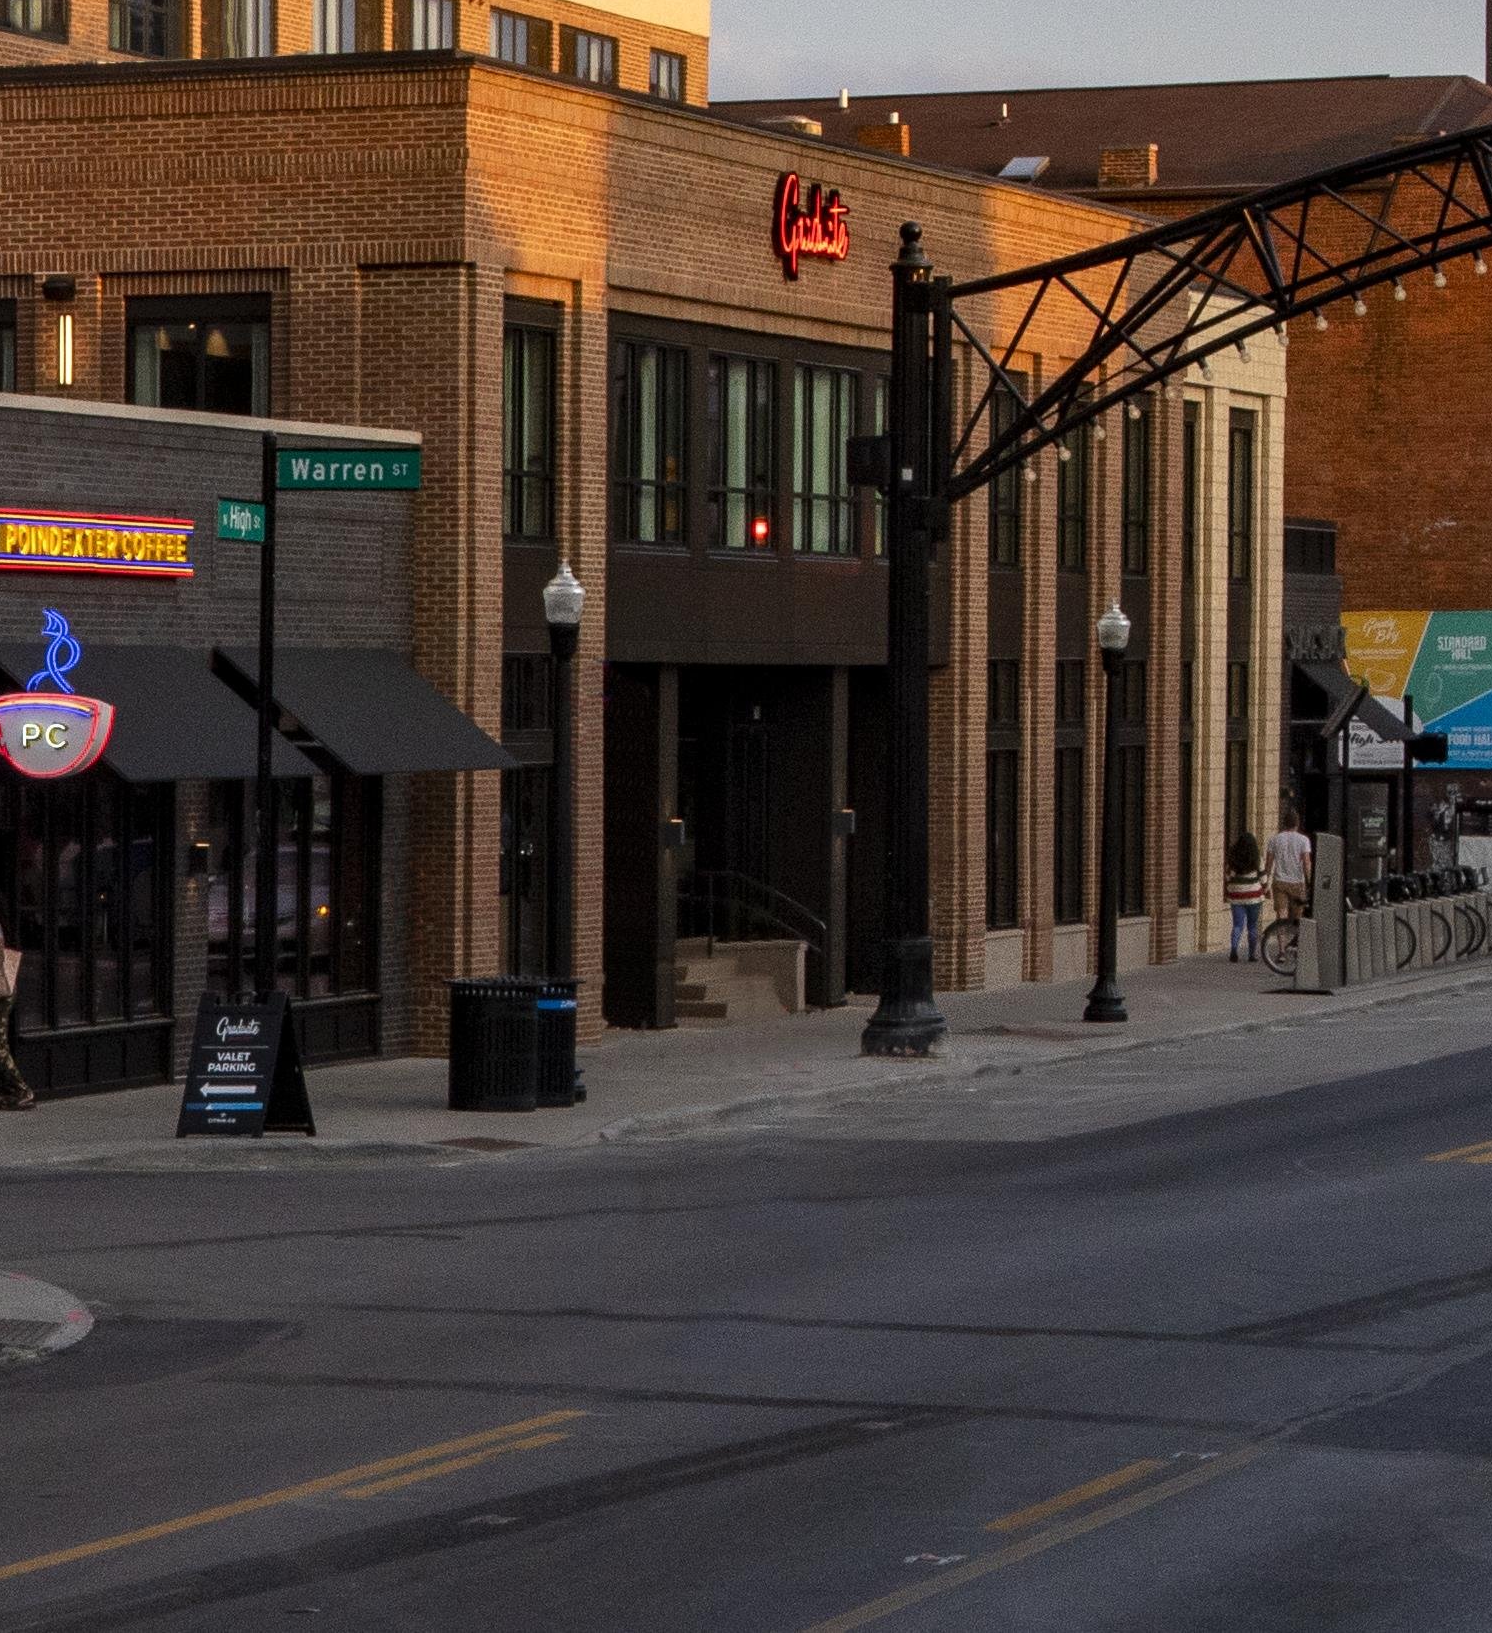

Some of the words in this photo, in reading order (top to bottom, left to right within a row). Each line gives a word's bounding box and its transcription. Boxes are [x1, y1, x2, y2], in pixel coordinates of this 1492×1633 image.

[291, 458, 384, 481] Warren
[392, 463, 409, 477] ST
[229, 505, 252, 537] High
[5, 523, 118, 559] POINDEXTER
[122, 531, 188, 563] COFFEE
[1437, 636, 1487, 651] STANDARD
[22, 723, 67, 749] PC
[216, 1016, 261, 1042] Graduate
[207, 1063, 257, 1072] PARKING
[217, 1052, 251, 1061] VALET
